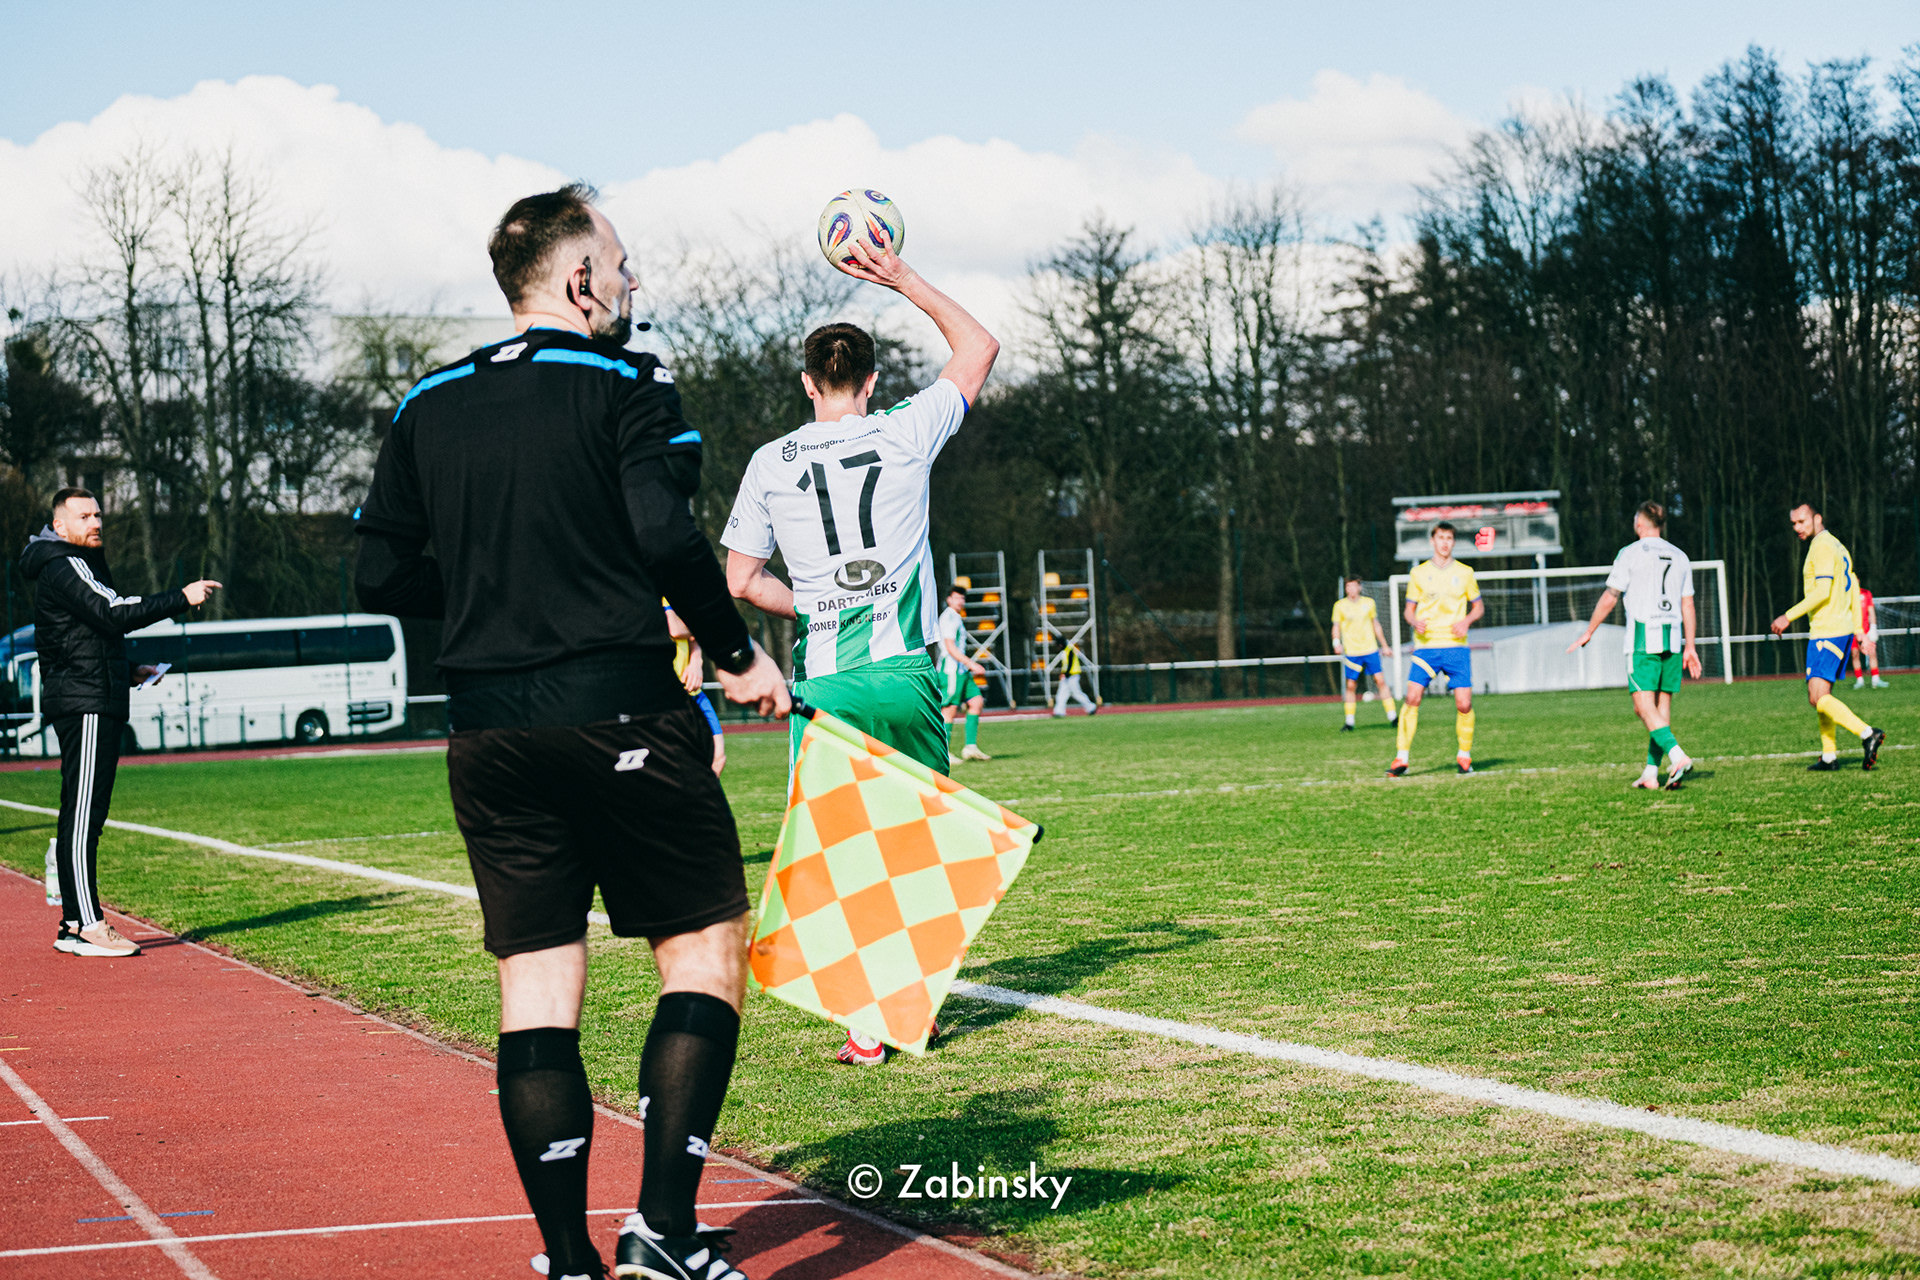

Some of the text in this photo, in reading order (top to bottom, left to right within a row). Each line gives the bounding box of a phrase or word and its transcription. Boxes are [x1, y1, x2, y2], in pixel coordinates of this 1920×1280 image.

[796, 449, 882, 556] 17
[1659, 555, 1672, 595] 7
[1843, 556, 1852, 592] 3
[817, 581, 897, 612] DARTEKS
